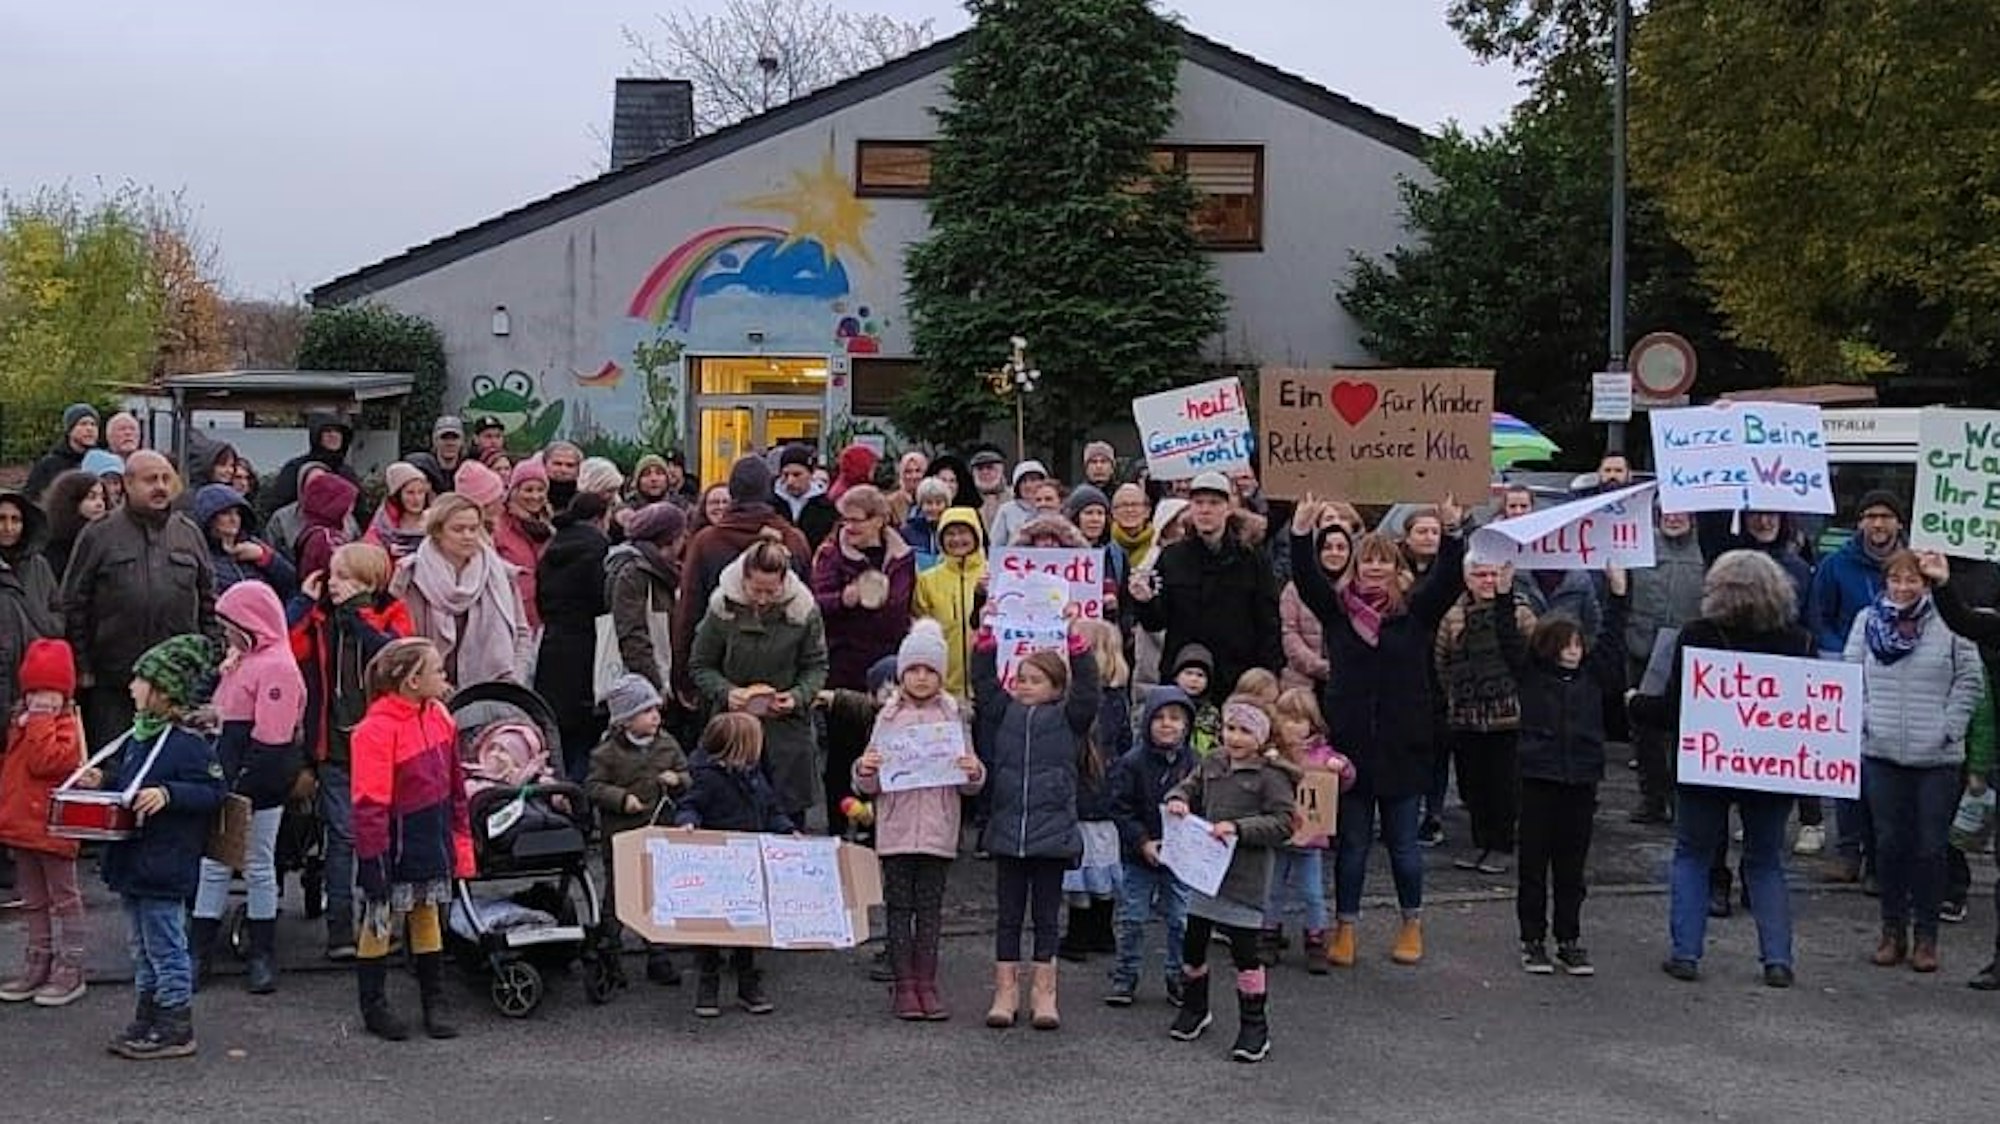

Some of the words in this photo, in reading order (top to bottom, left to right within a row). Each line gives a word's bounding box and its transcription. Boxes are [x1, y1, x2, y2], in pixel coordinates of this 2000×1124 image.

[1280, 380, 1322, 408] Ein
[1380, 388, 1416, 420] für
[1422, 383, 1483, 414] Kinder
[1268, 431, 1336, 466] Rettet
[1350, 442, 1416, 468] unsere
[1426, 429, 1472, 461] Kita
[1744, 414, 1822, 448] Beine
[1751, 455, 1823, 496] Wege
[1934, 475, 1978, 505] Ihr
[1693, 658, 1780, 700] Kita
[1806, 674, 1844, 701] im
[1736, 701, 1850, 734] Veedel
